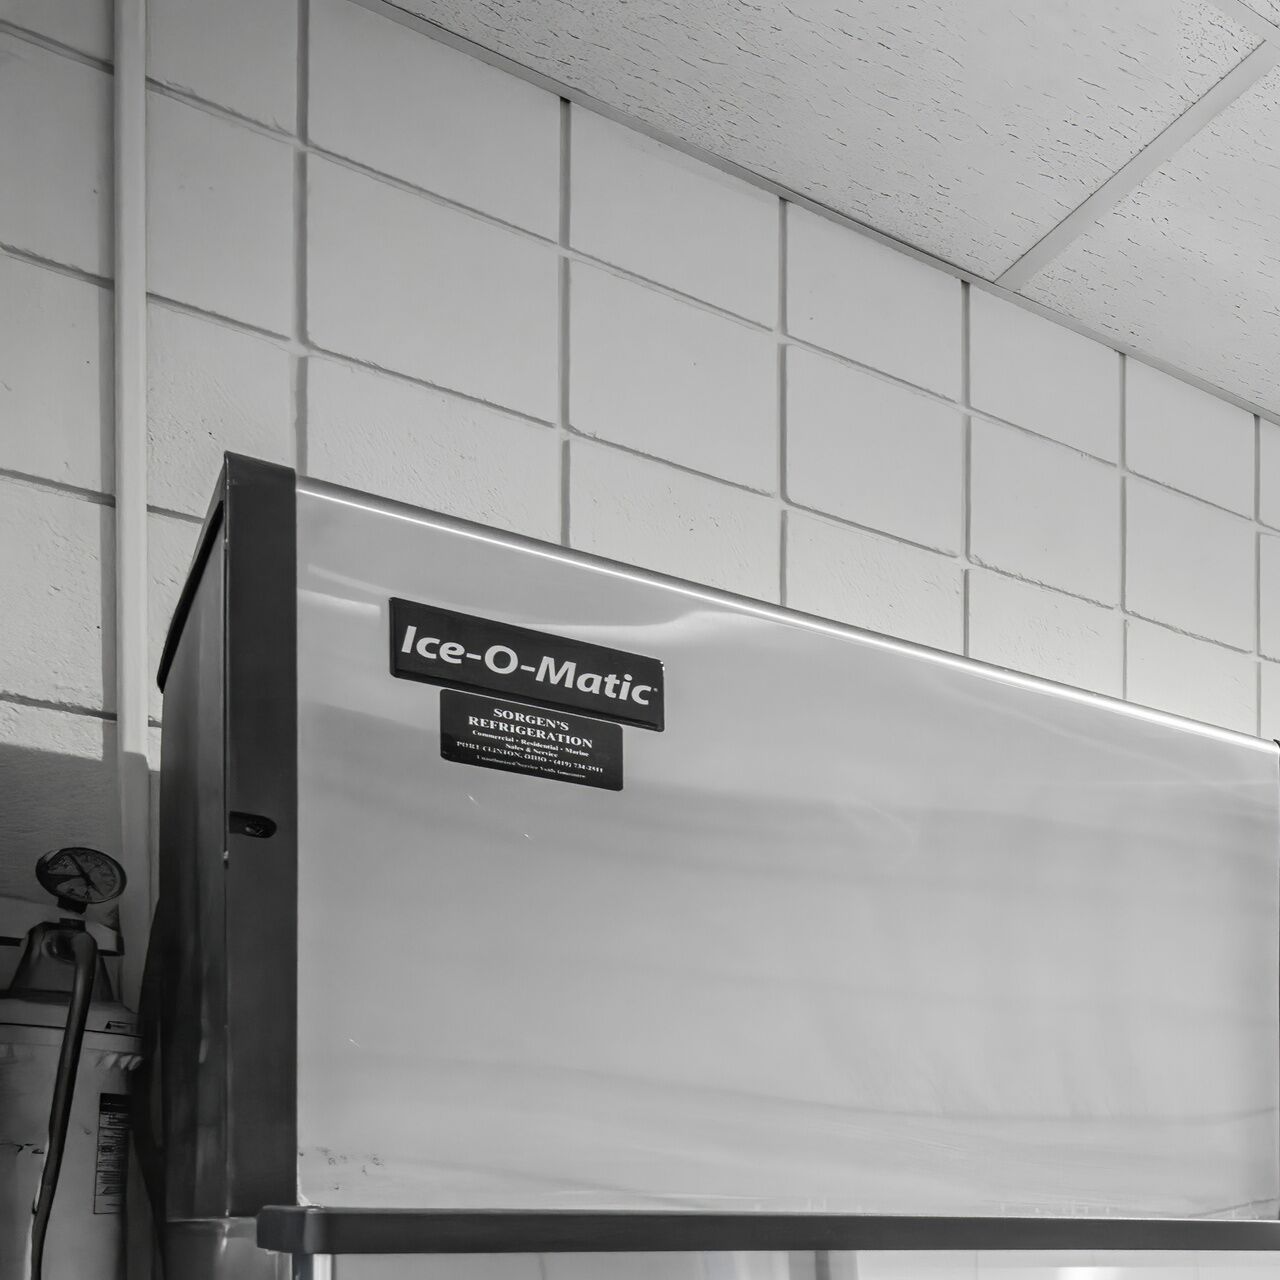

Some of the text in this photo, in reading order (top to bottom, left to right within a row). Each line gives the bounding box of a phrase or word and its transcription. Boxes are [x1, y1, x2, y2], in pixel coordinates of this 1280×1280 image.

[401, 625, 651, 706] Ice-O-Matic
[468, 716, 593, 748] REFRIGERATION
[493, 708, 569, 731] SORGEN'S
[456, 741, 479, 750] PORT
[472, 730, 589, 757] Commercial Residential Marine
[505, 743, 524, 752] Sales
[533, 748, 558, 758] Service
